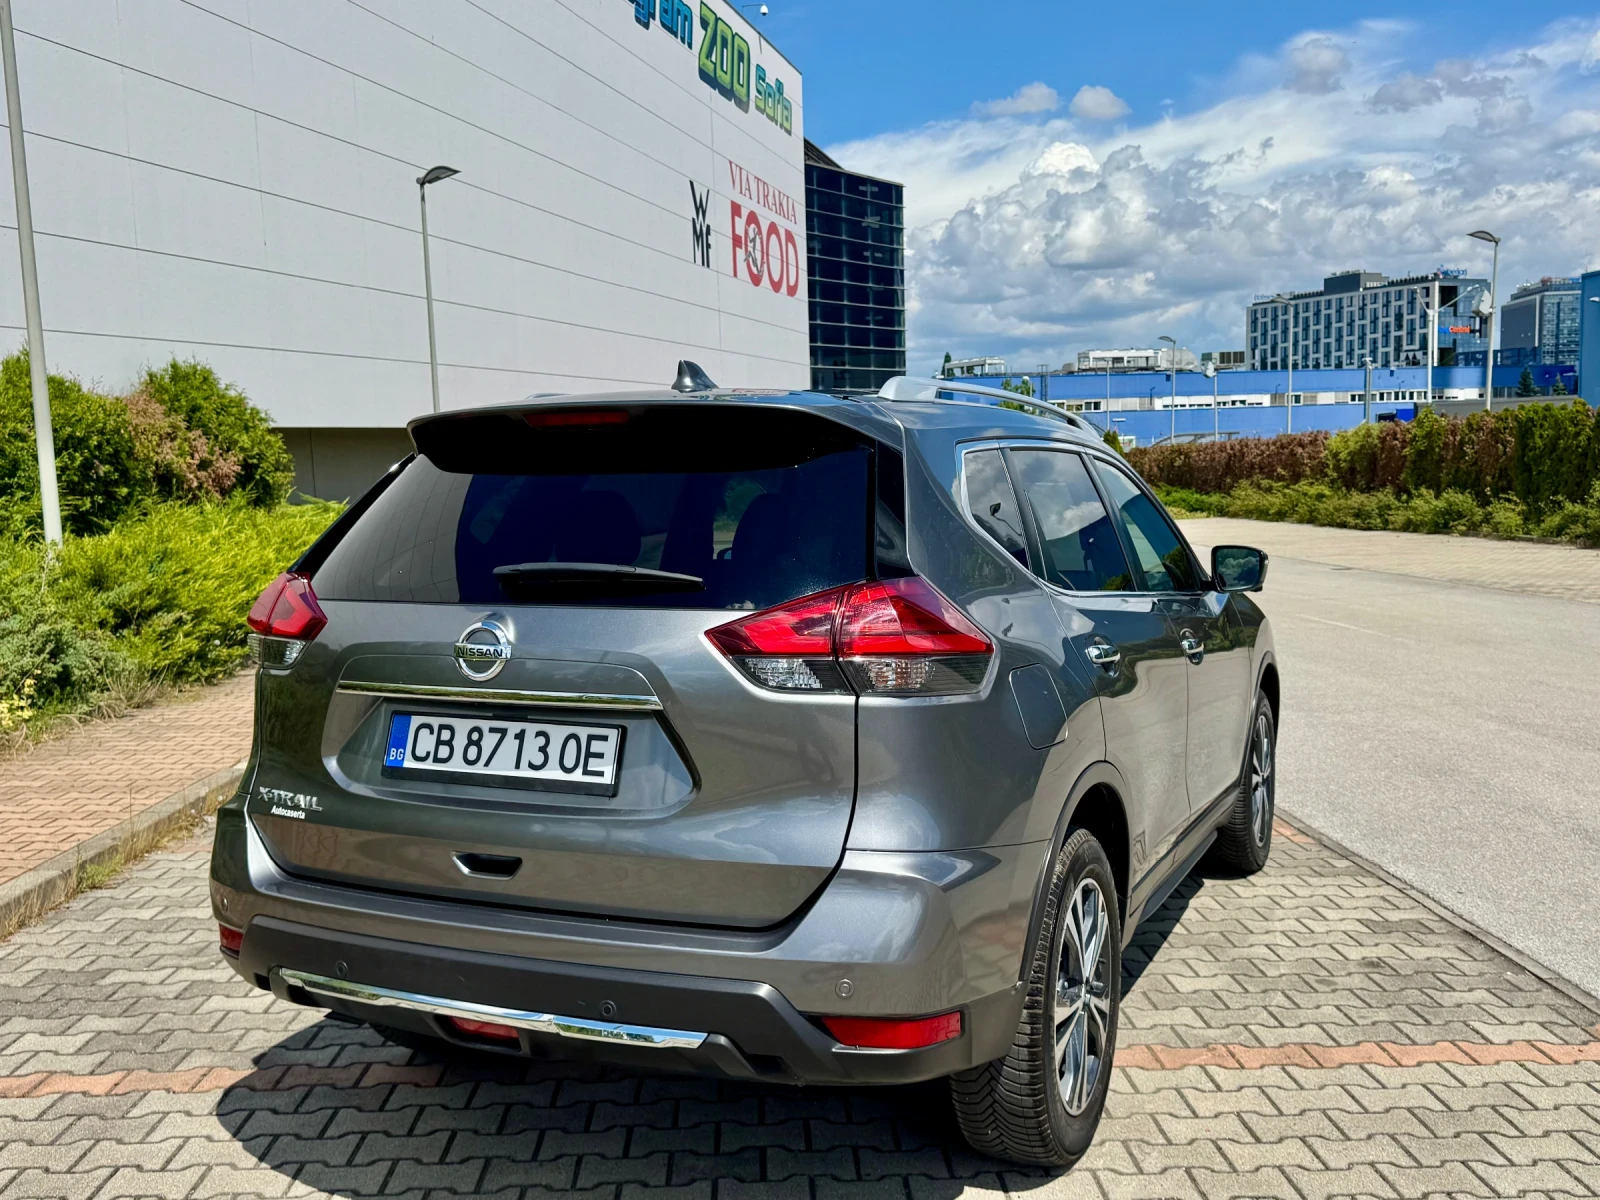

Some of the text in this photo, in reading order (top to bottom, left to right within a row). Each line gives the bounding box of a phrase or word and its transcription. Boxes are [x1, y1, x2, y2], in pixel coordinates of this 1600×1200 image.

[729, 160, 797, 225] VIA TRAKIA
[730, 200, 799, 297] FOOD
[457, 646, 504, 658] NISSAN
[389, 747, 405, 761] BG
[410, 722, 456, 764] CB
[462, 725, 551, 771] 8713
[258, 786, 323, 811] X-TRAIL
[270, 805, 306, 819] Autocaserta
